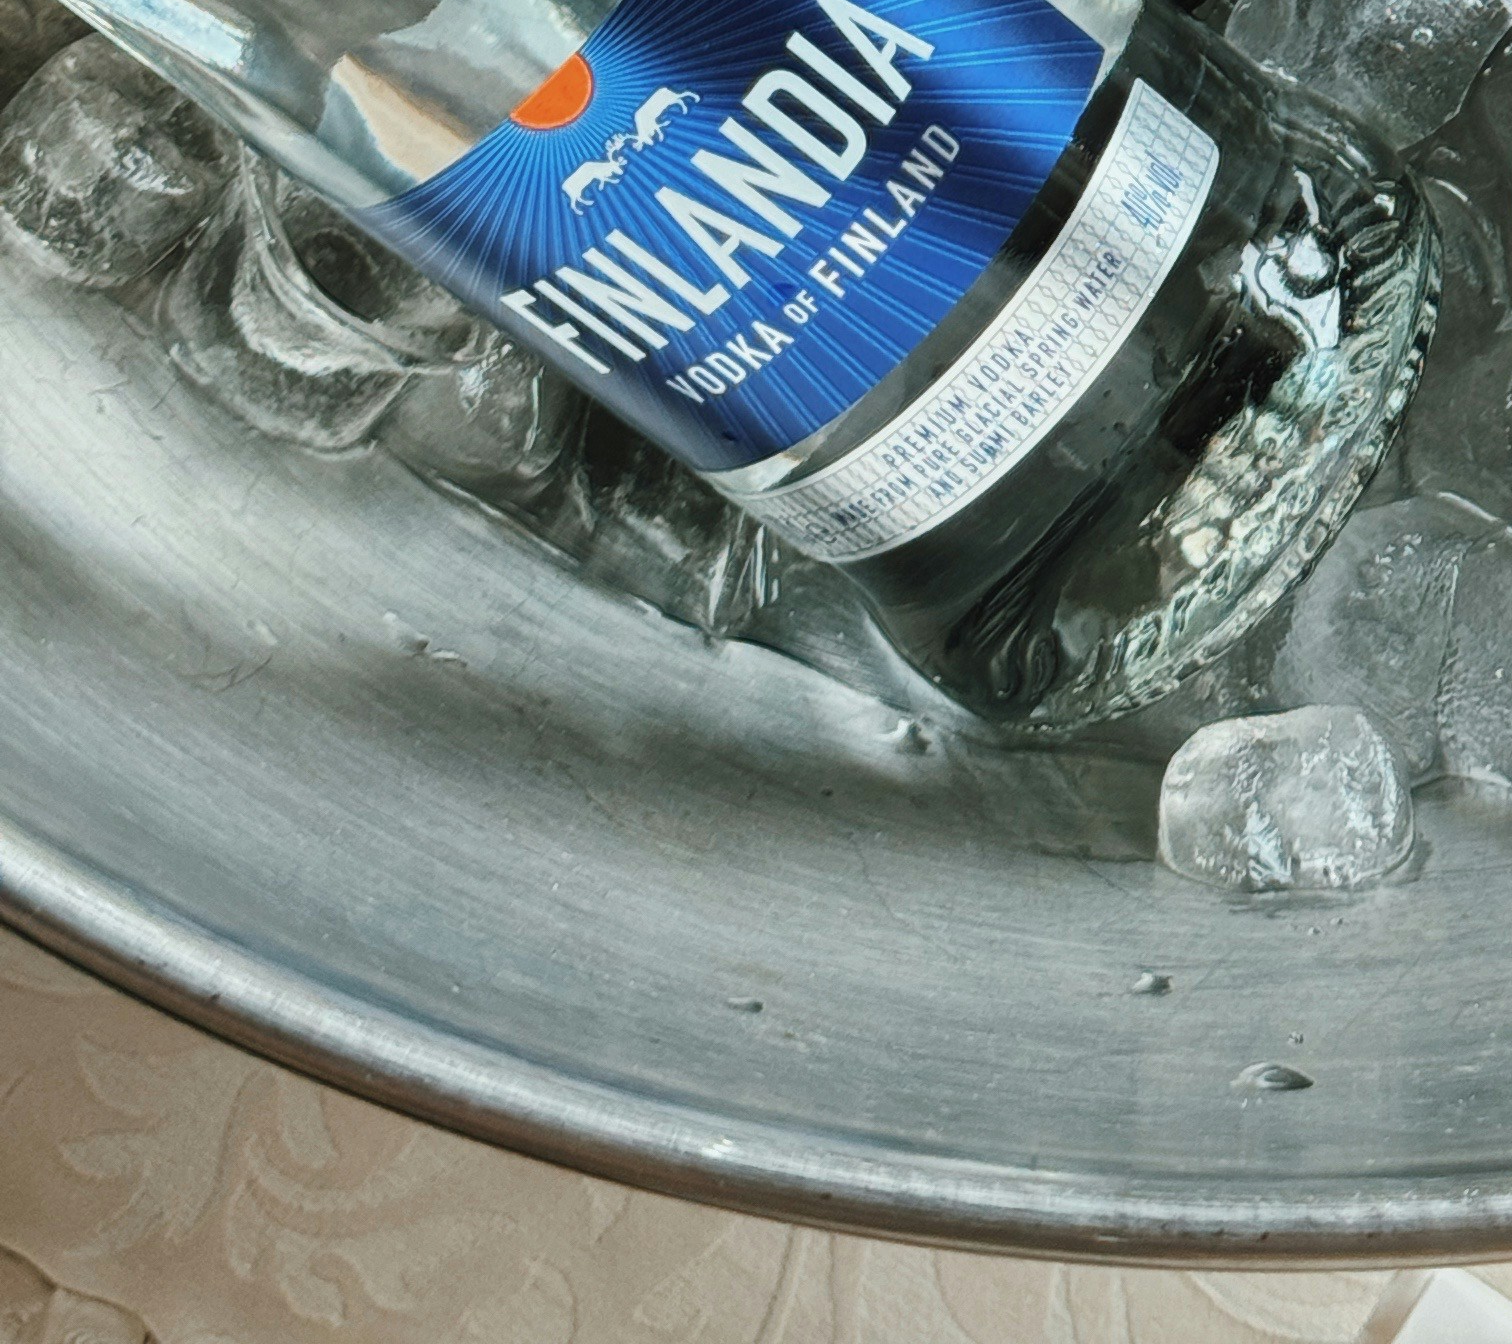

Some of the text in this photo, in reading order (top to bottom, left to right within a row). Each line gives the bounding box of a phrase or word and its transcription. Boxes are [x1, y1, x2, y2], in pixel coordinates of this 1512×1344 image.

[666, 124, 962, 404] VODKA OF FINLAND
[870, 474, 912, 509] FROM
[913, 443, 960, 481] PURE
[956, 380, 1027, 445] GLACIAL
[1022, 311, 1079, 379] SPRING
[1073, 251, 1123, 312] WATER
[882, 328, 1036, 470] PREMIUM VODKA
[931, 467, 964, 502] AND
[1010, 363, 1074, 426] BARLEY
